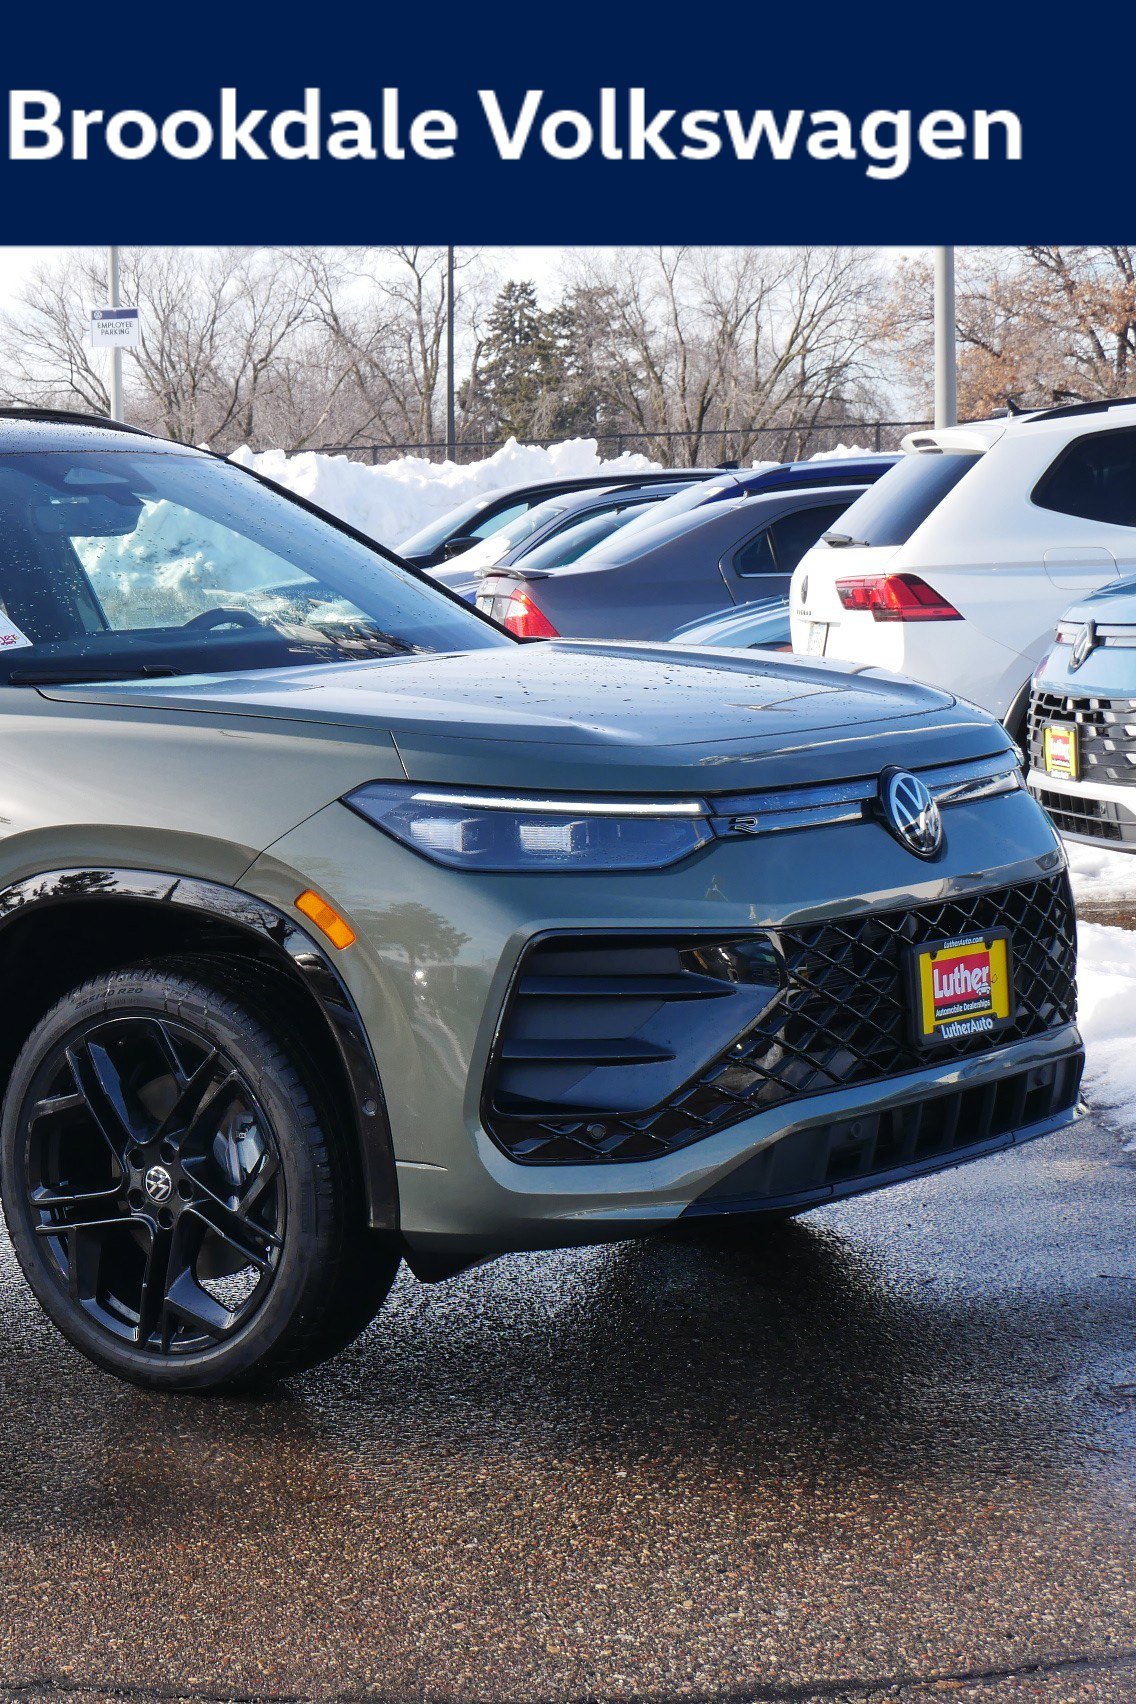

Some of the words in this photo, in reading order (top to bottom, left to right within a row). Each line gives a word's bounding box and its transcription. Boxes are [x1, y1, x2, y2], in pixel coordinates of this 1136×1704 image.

[97, 321, 133, 329] EMPLOYEE
[100, 328, 130, 336] PARKING
[943, 936, 984, 949] LutherAuto.com
[933, 963, 990, 999] Luther
[935, 1004, 963, 1018] Automobile
[963, 999, 991, 1012] Dealerships
[940, 1017, 993, 1039] LutherAuto
